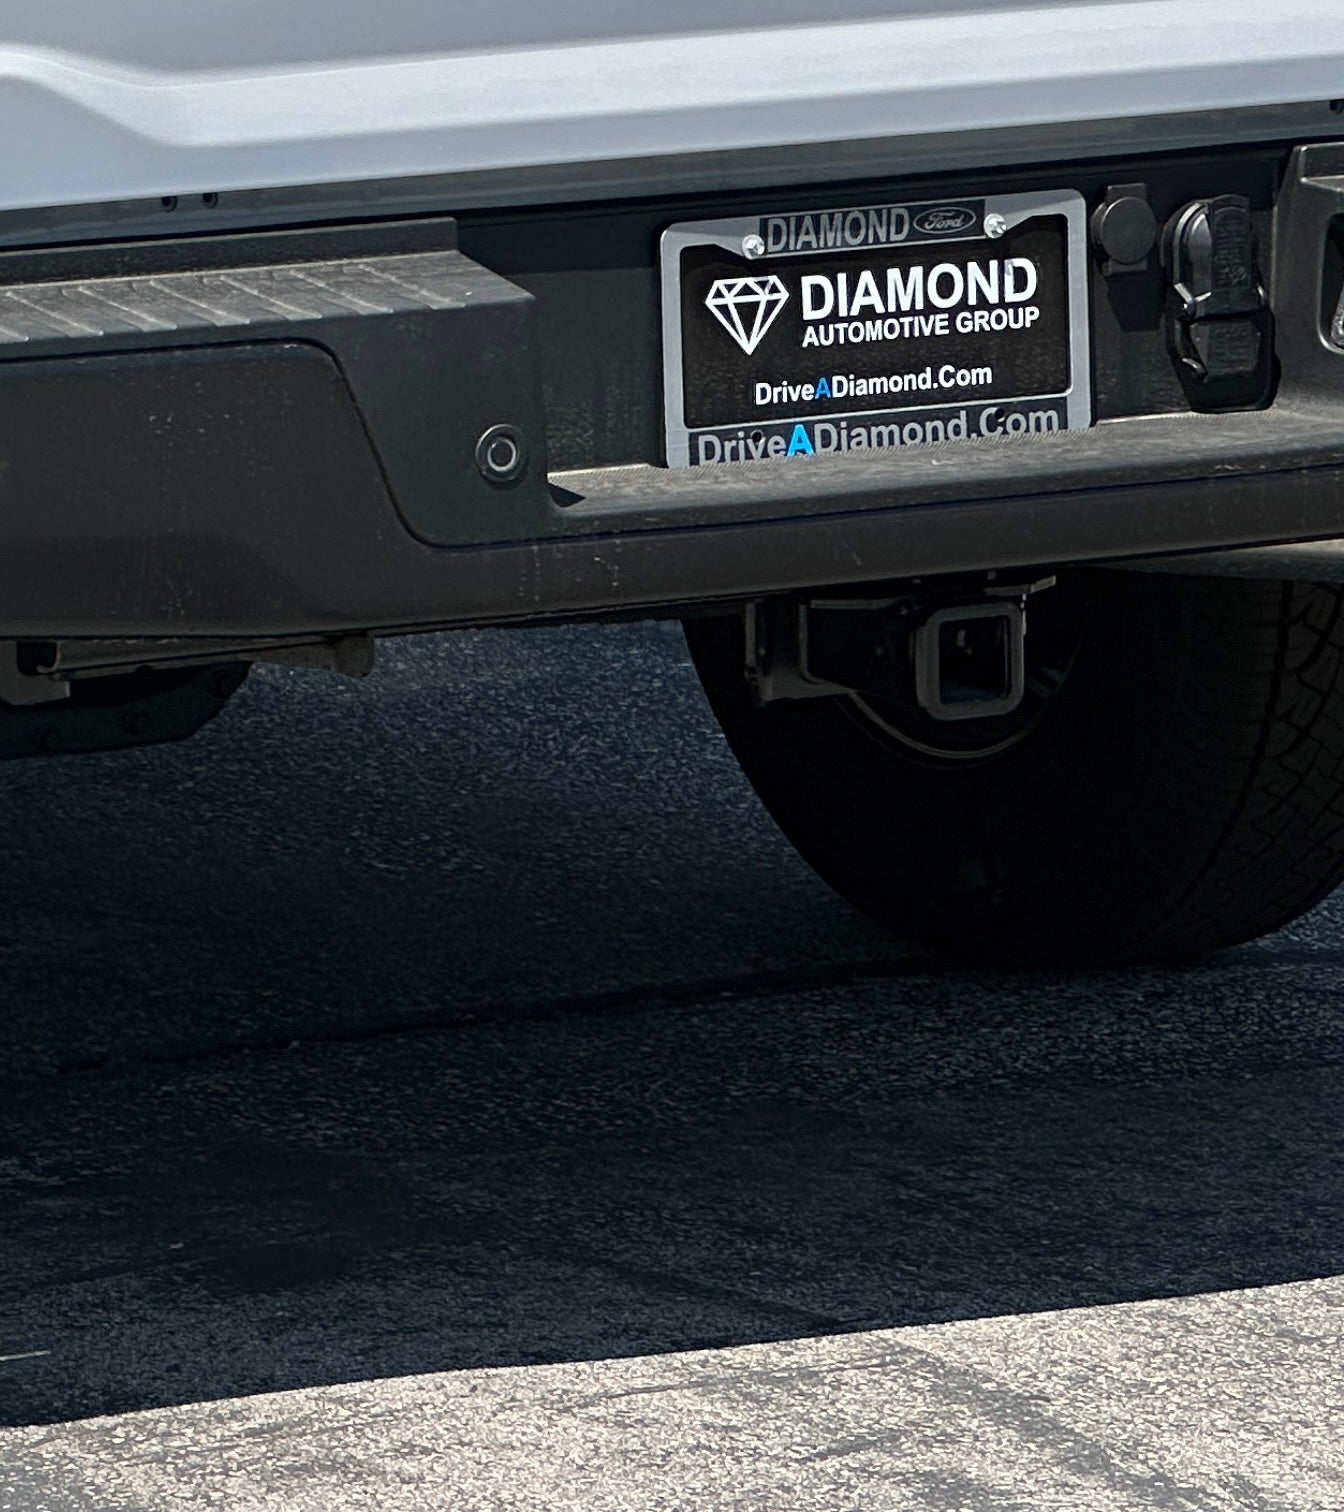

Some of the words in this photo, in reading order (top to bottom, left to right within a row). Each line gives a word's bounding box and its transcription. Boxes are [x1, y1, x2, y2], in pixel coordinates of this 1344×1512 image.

[766, 207, 910, 253] DIAMOND
[923, 209, 970, 230] Ford
[801, 256, 1038, 321] DIAMOND
[802, 313, 949, 348] AUTOMOTIVE
[957, 307, 1040, 334] GROUP
[755, 364, 992, 406] DriveADiamond.Com
